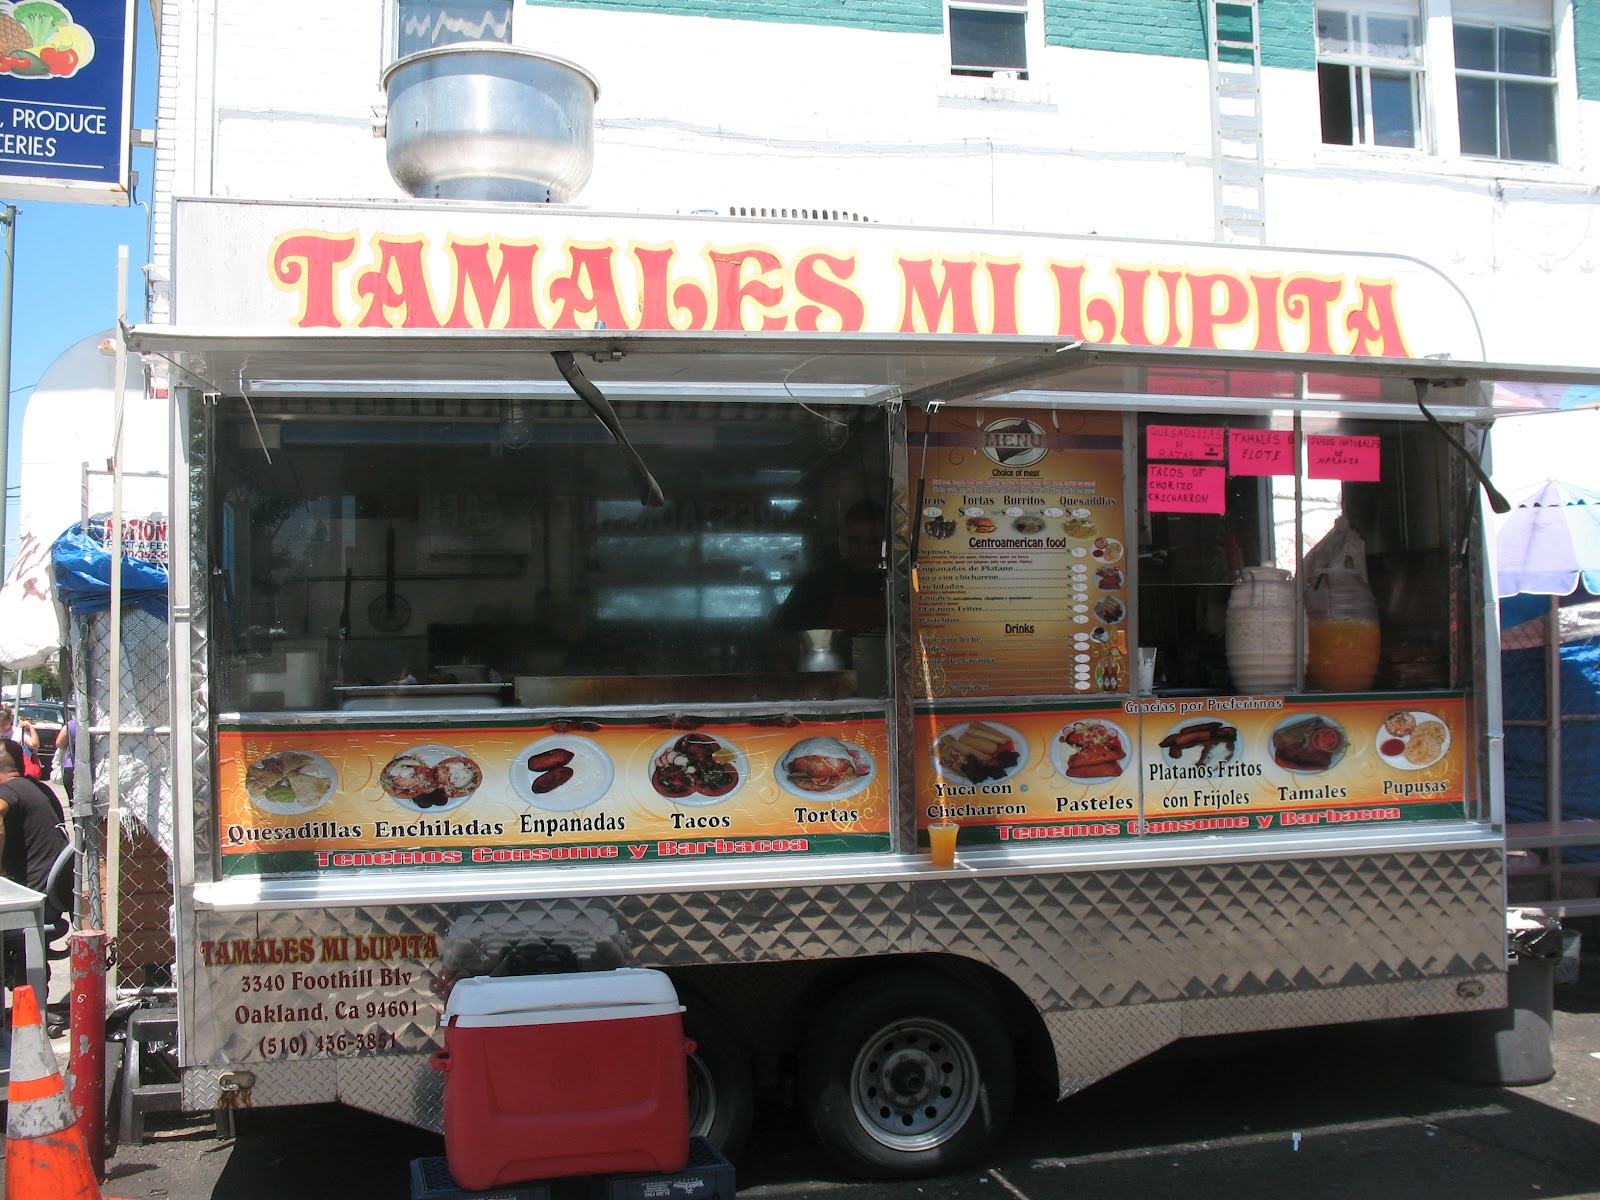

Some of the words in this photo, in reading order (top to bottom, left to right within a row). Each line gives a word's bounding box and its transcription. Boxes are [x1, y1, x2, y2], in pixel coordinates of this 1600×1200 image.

[12, 108, 107, 135] PRODUCE
[267, 229, 868, 331] TAMALES
[893, 249, 1024, 336] MI
[1044, 256, 1416, 358] LUPITA
[985, 434, 1043, 447] MENU
[1150, 427, 1222, 440] QUESADILLAS
[1232, 433, 1281, 445] TAMALES
[1311, 437, 1335, 446] JUGOS
[1340, 438, 1381, 449] NATURALES
[1158, 449, 1194, 459] RAJAS
[1241, 448, 1282, 461] ELOTE
[992, 469, 1014, 477] Choice
[1015, 469, 1022, 477] of
[1023, 469, 1040, 477] meat
[1150, 466, 1184, 478] TACOS
[1191, 467, 1206, 478] DE
[1149, 480, 1193, 491] CHORIZO
[962, 495, 995, 506] Tortas
[1003, 495, 1046, 506] Burritos
[1060, 496, 1116, 507] Quesadillas
[969, 537, 1045, 549] Centroamerican
[1046, 537, 1066, 549] food
[1004, 623, 1035, 635] Drinks
[1180, 700, 1204, 714] por
[1206, 697, 1284, 712] Preferirnos
[1149, 762, 1213, 781] Platanos
[1216, 759, 1263, 779] Fritos
[934, 783, 979, 797] Yuca
[981, 783, 1013, 796] con
[1277, 784, 1348, 802] Tamales
[1382, 779, 1449, 798] Pupusas
[1055, 795, 1134, 813] Pasteles
[1162, 794, 1189, 809] con
[1192, 788, 1250, 811] Frijoles
[793, 807, 859, 825] Tortas
[926, 802, 1028, 820] Chicharron
[373, 819, 504, 840] Enchiladas
[519, 811, 626, 837] Enpanadas
[670, 812, 732, 830] Tacos
[996, 822, 1121, 841] Tenemos
[1127, 816, 1250, 836] Consome
[1256, 813, 1273, 830] y
[1279, 807, 1401, 826] Barbacoa
[227, 821, 362, 845] Quesadillas
[314, 849, 463, 867] Tenemos
[471, 844, 619, 863] Consome
[627, 842, 649, 860] y
[656, 838, 809, 857] Barbacoa
[199, 936, 316, 967] TAMALES
[320, 935, 349, 963] MI
[353, 932, 440, 962] LUPITA
[241, 974, 285, 993] 3340
[291, 969, 373, 990] Foothill
[379, 967, 413, 987] Blv
[234, 1001, 329, 1025] Oakland,
[335, 1001, 359, 1019] Ca
[366, 1000, 419, 1019] 94601
[258, 1035, 308, 1058] (510)
[314, 1032, 397, 1053] 436-3851
